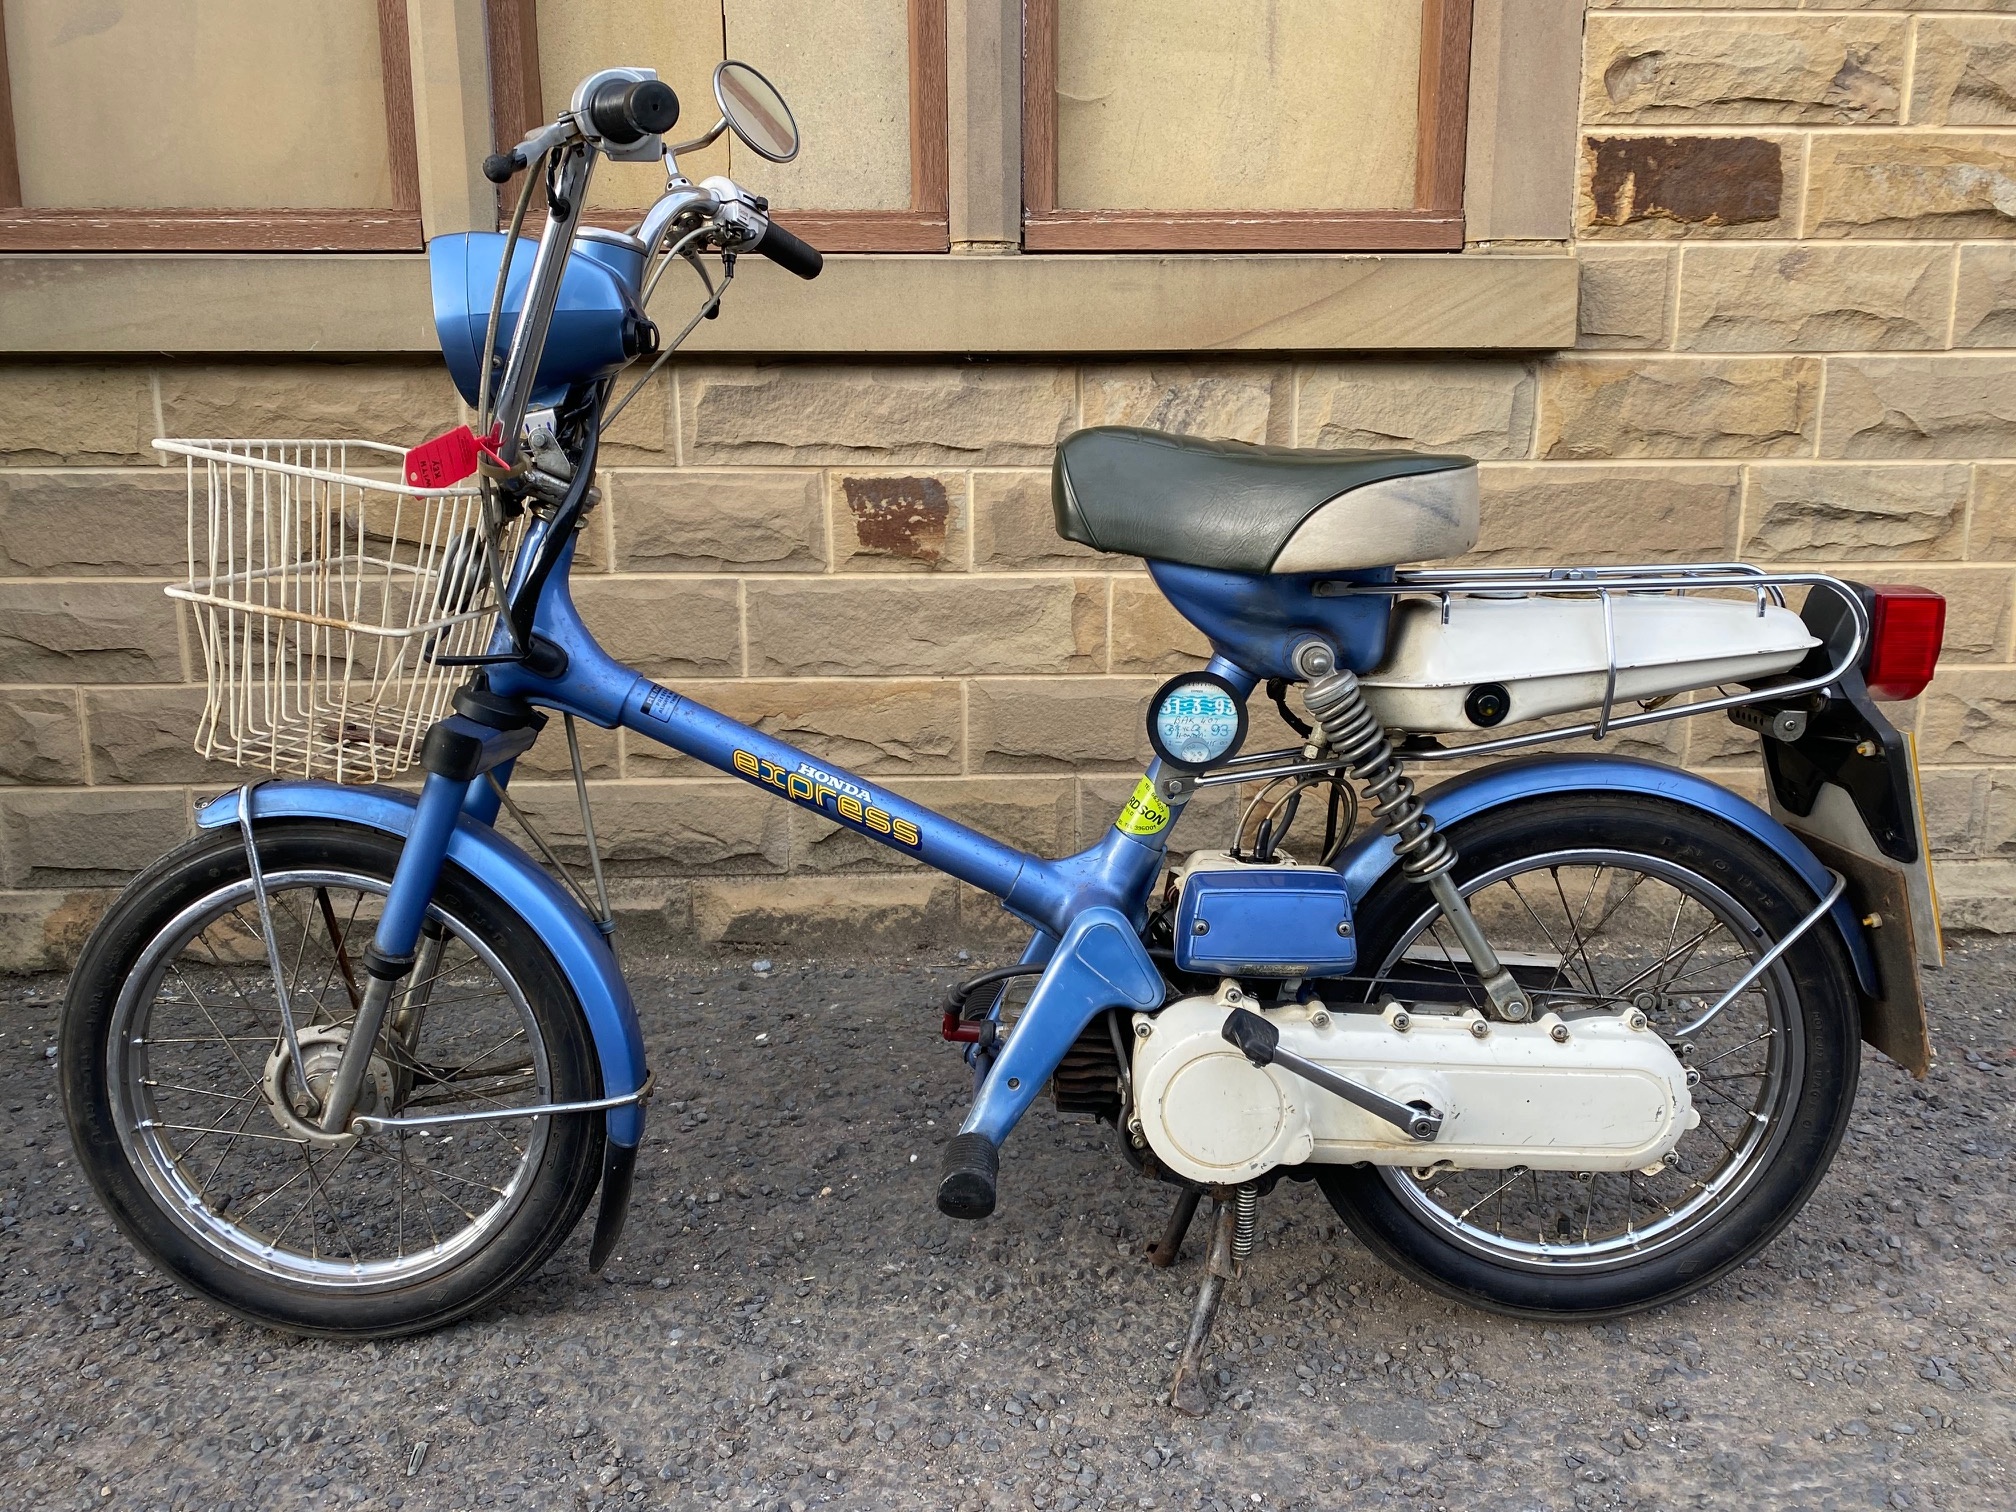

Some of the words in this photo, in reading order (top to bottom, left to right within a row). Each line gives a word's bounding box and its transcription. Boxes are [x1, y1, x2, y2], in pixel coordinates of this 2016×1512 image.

[420, 460, 432, 488] WITH
[432, 460, 441, 479] KEY
[733, 749, 919, 846] express
[797, 763, 873, 803] HONDA
